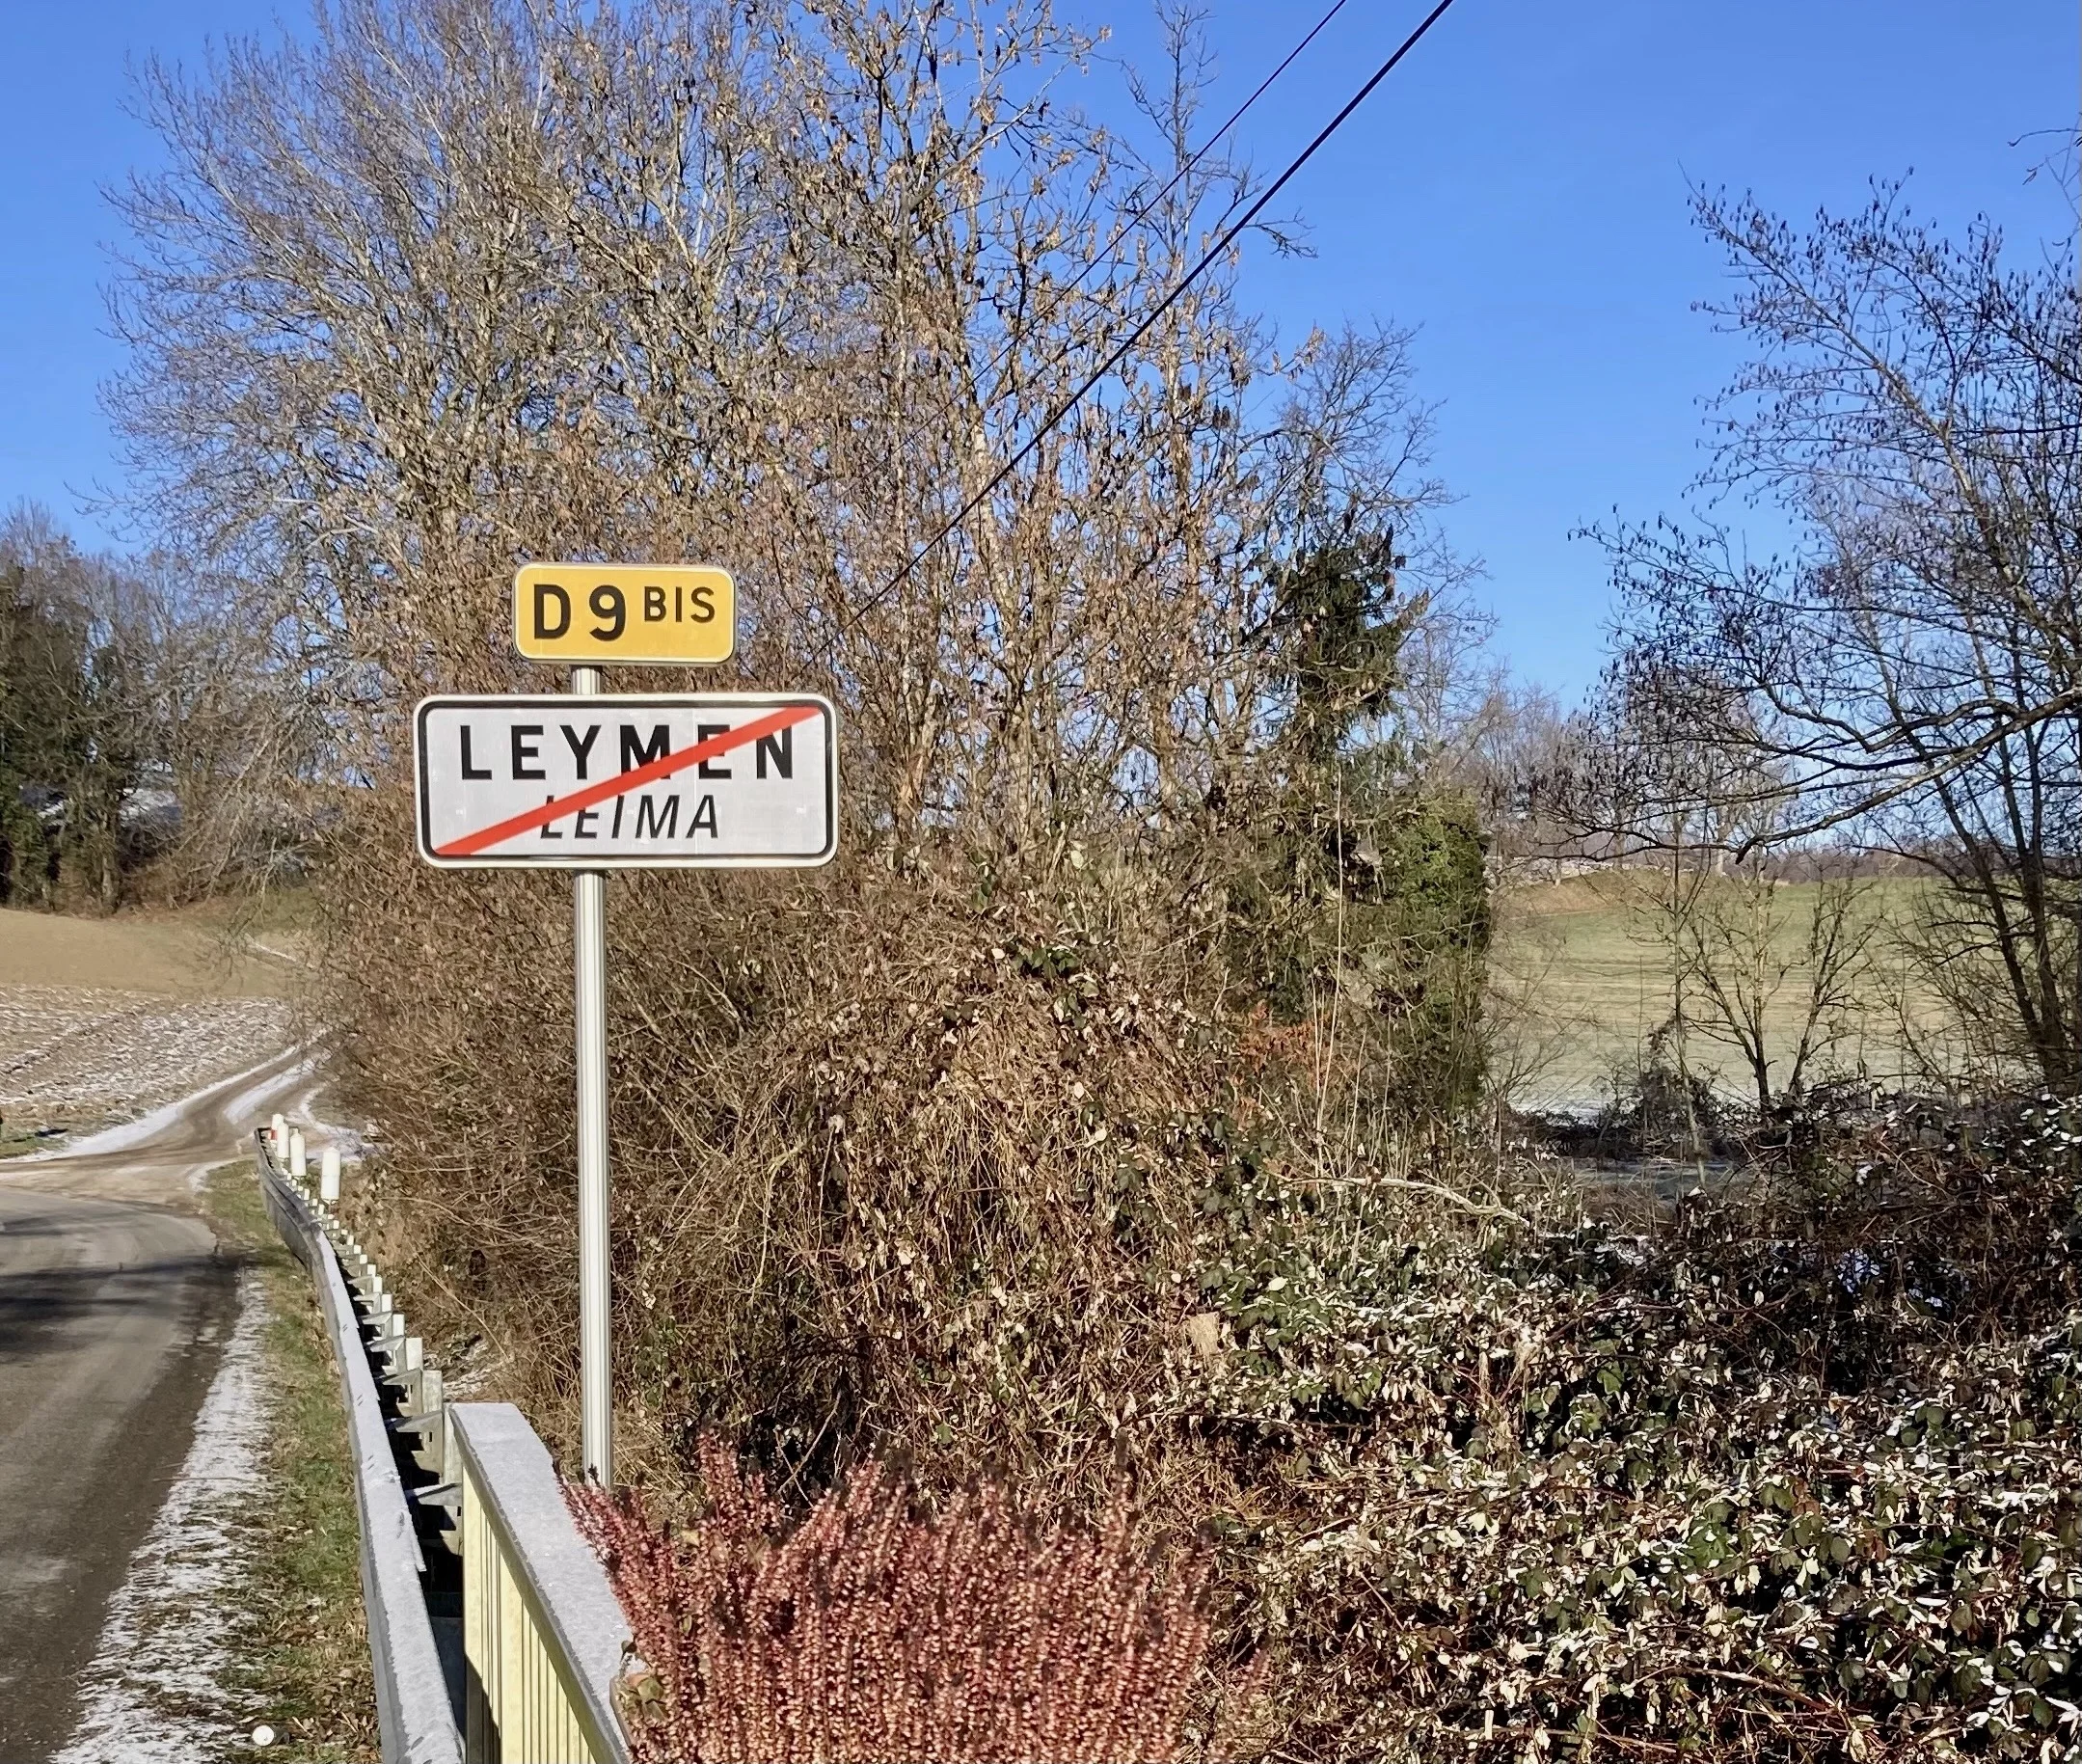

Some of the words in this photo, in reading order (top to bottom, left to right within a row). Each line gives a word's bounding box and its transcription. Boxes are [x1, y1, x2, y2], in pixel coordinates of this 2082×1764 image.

[533, 583, 571, 639] D
[589, 584, 627, 641] 9
[643, 585, 716, 623] BIS
[459, 724, 794, 780] LEYMEN
[540, 794, 719, 840] LEIMA
